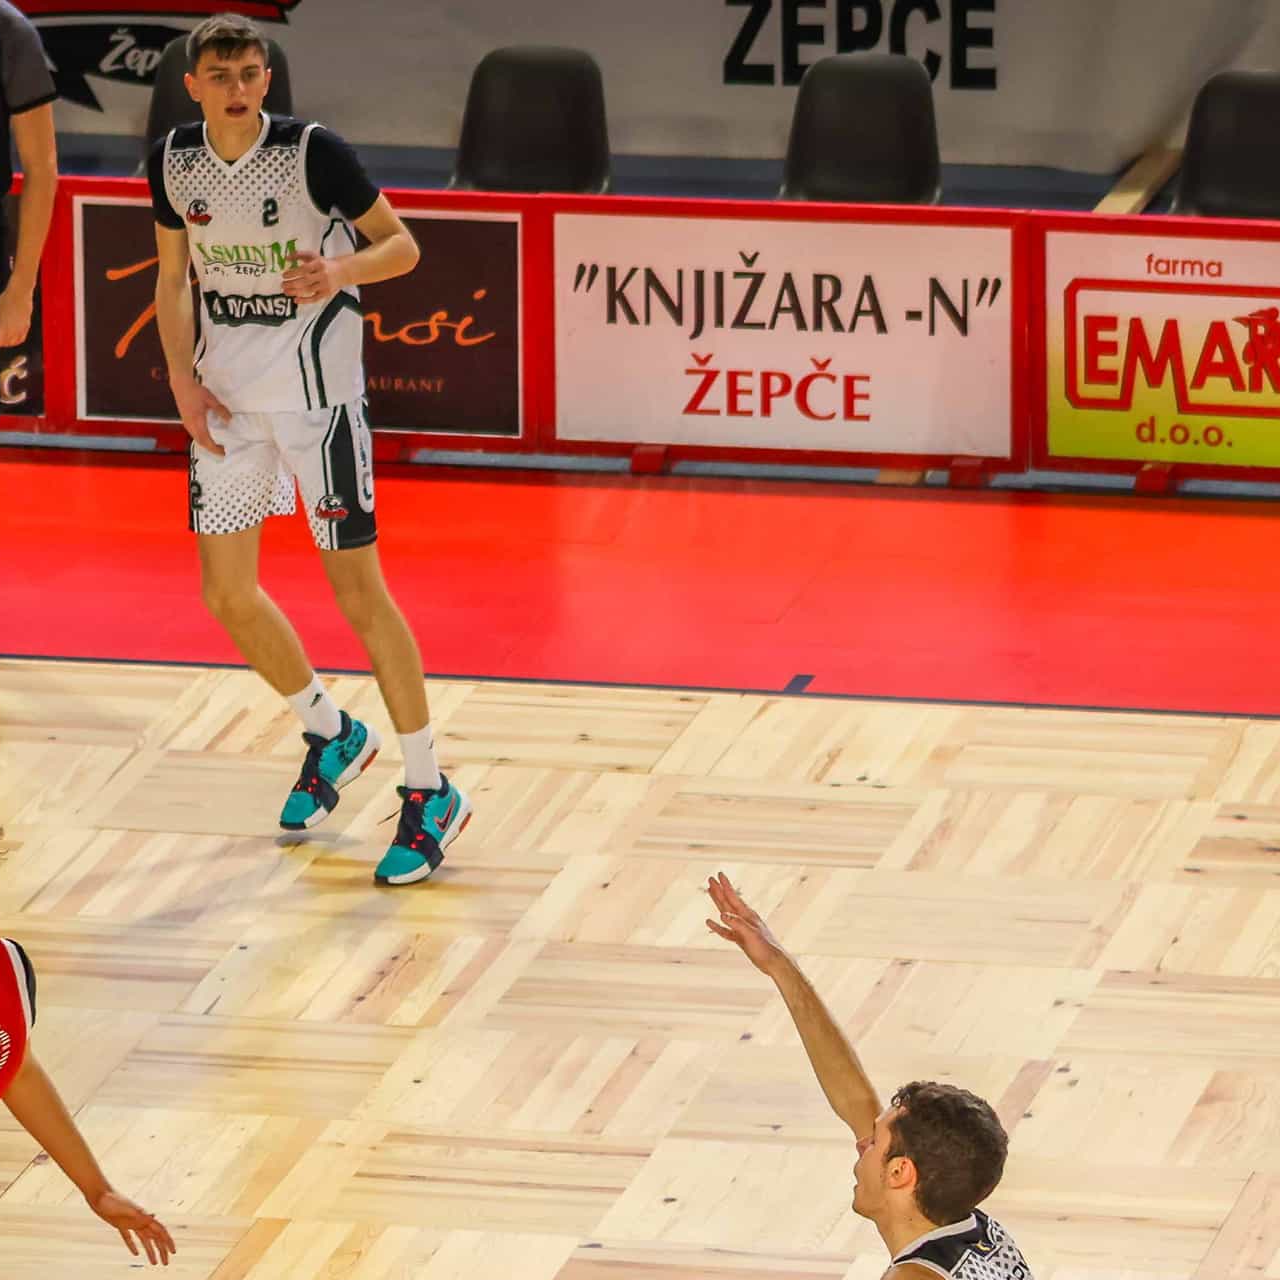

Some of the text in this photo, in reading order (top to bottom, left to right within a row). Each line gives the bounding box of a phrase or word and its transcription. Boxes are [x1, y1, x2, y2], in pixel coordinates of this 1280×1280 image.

[100, 27, 162, 76] Žep
[262, 198, 280, 228] 2
[1146, 254, 1224, 279] farma
[367, 375, 445, 394] AURANT
[682, 353, 871, 422] ŽEPČE
[1135, 416, 1234, 448] d.o.o.
